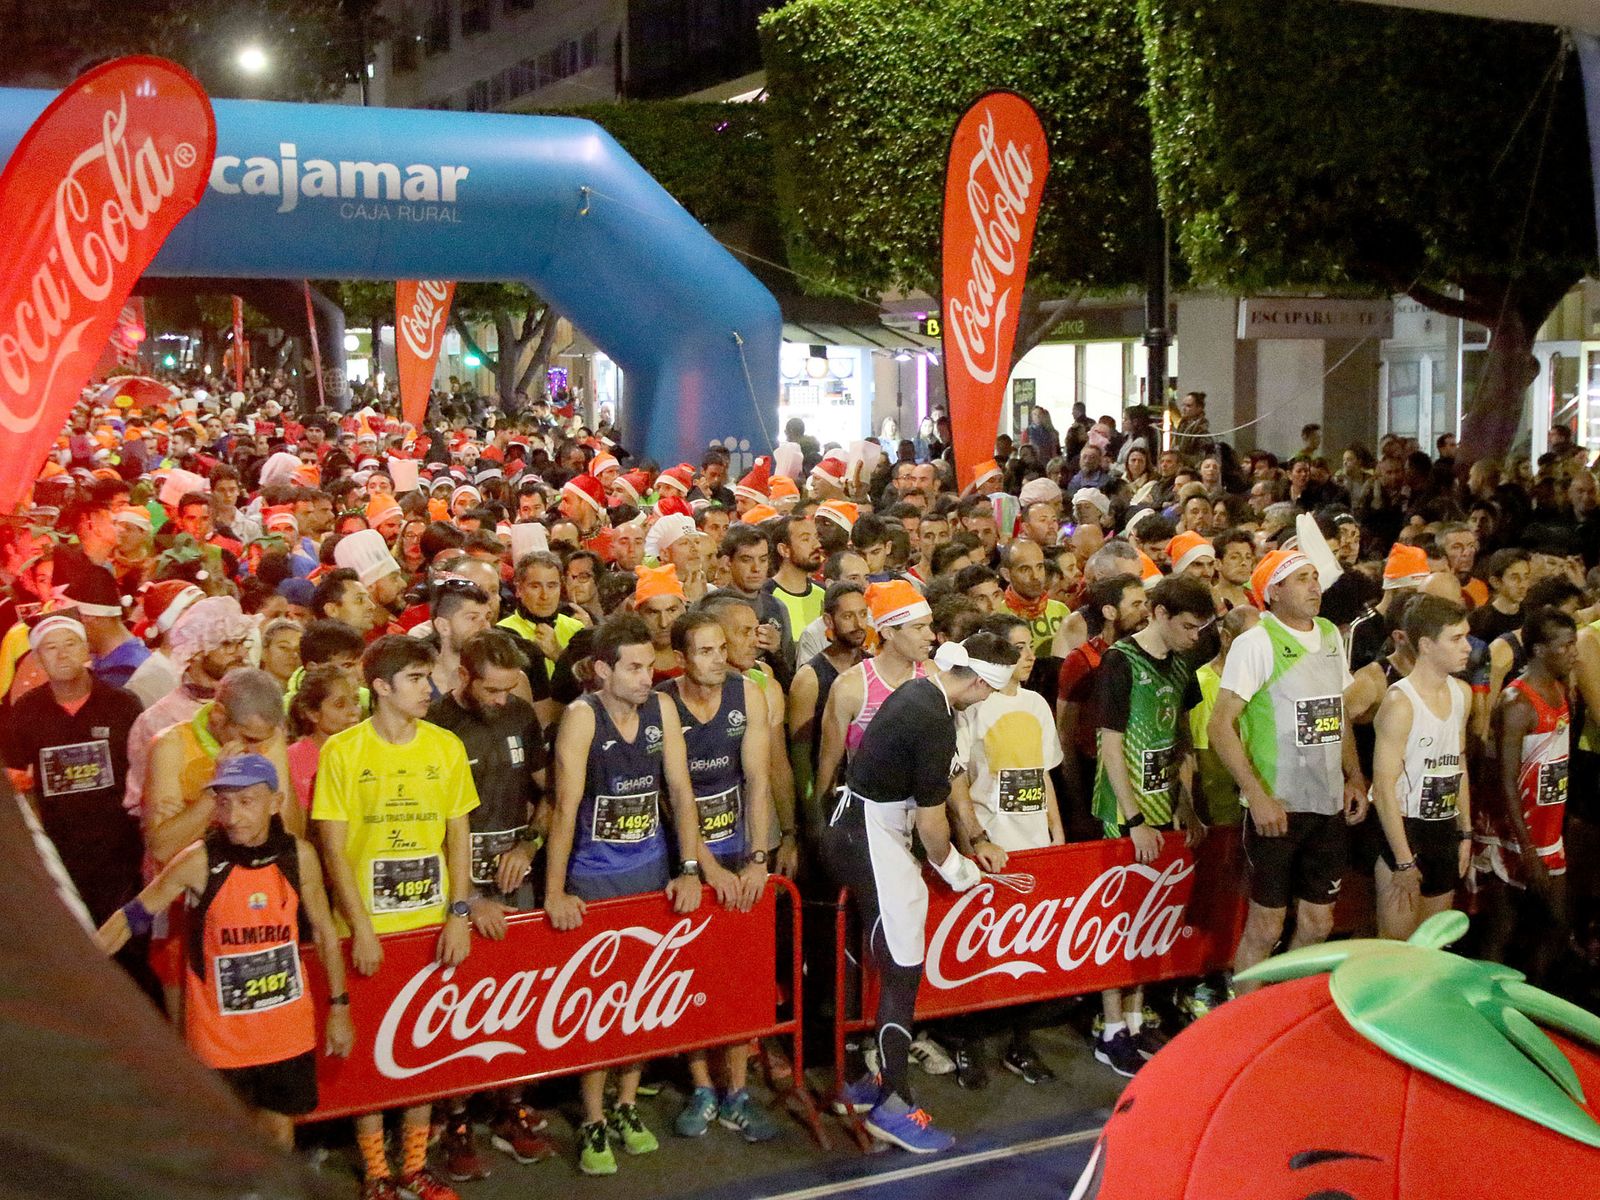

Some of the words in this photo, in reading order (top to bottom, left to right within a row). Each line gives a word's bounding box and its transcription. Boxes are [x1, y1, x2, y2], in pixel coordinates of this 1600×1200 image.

[208, 142, 470, 214] cajamar
[340, 203, 391, 221] CAJA
[398, 204, 462, 223] RURAL
[950, 106, 1033, 384] Coca-Cola
[1018, 787, 1042, 802] 2425
[617, 814, 650, 830] 1492
[703, 811, 735, 831] 2400
[396, 878, 433, 897] 1897
[925, 858, 1197, 990] Coca-Cola
[245, 970, 289, 997] 2187
[373, 914, 713, 1080] Coca-Cola
